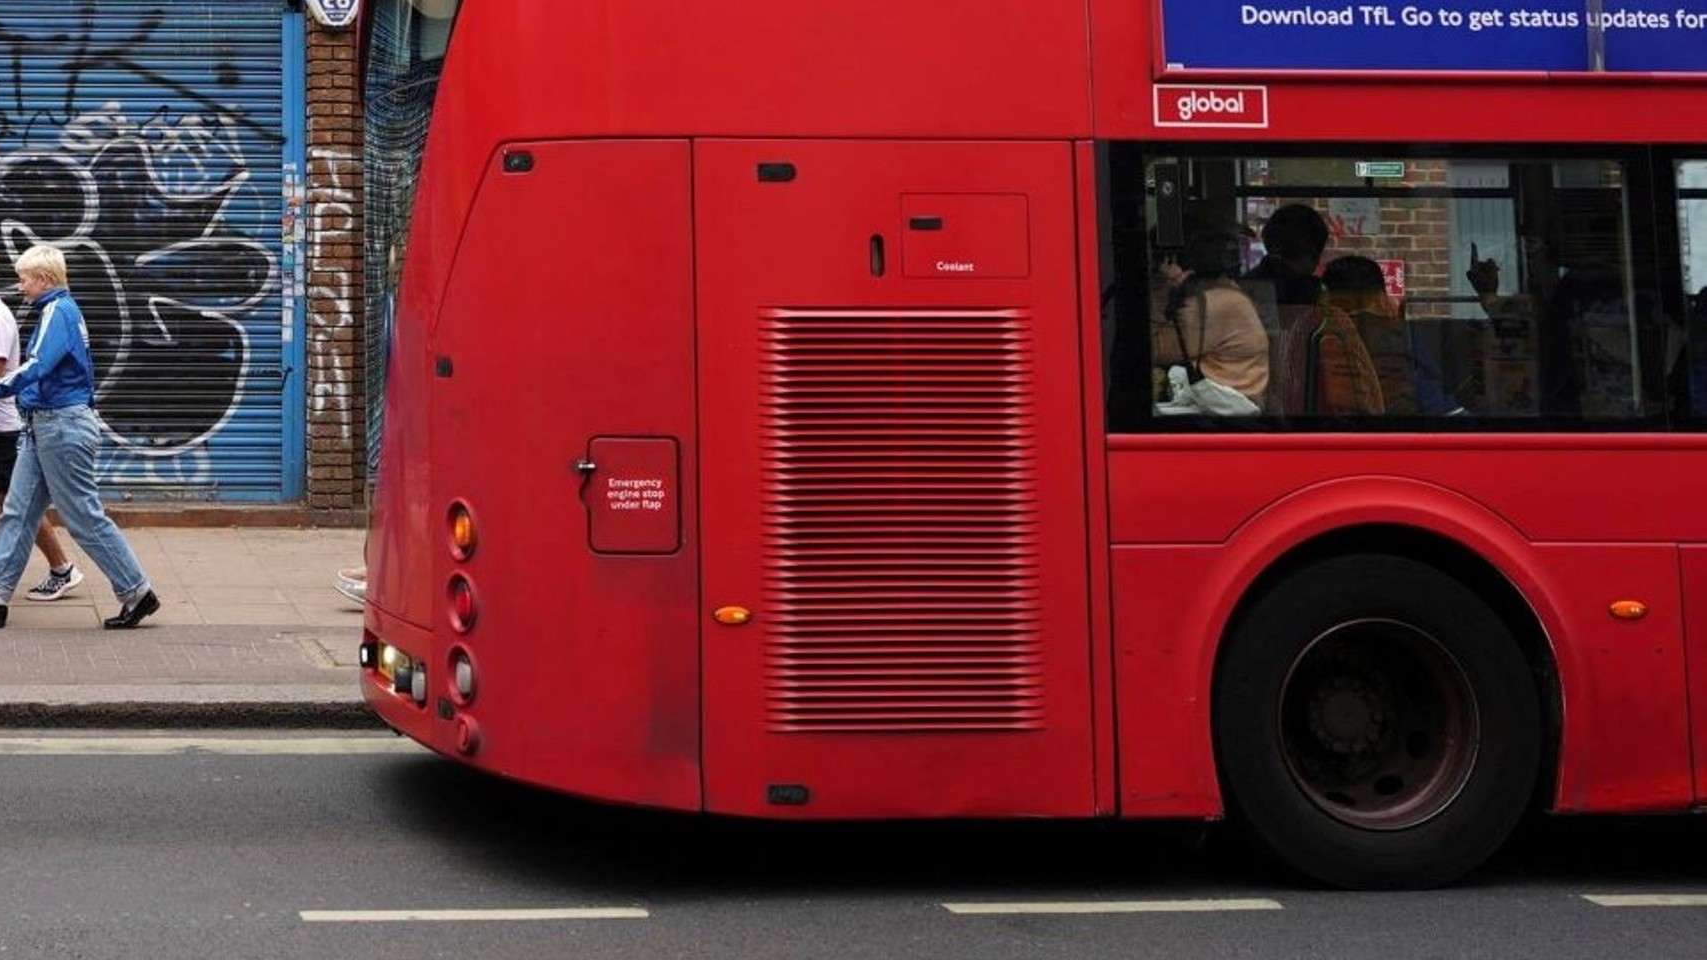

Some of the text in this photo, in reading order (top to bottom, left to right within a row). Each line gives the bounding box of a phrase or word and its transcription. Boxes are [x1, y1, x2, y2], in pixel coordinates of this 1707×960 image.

[1242, 5, 1353, 27] Download
[1359, 6, 1395, 26] TfL
[1401, 7, 1433, 27] Go
[1439, 8, 1462, 27] to
[1469, 9, 1502, 31] get
[1509, 9, 1579, 28] status
[1586, 8, 1670, 32] updates
[1177, 90, 1244, 120] global
[936, 261, 974, 272] Coolant
[608, 478, 662, 489] Emergency
[607, 489, 665, 500] engine stop
[610, 500, 662, 511] under flap
